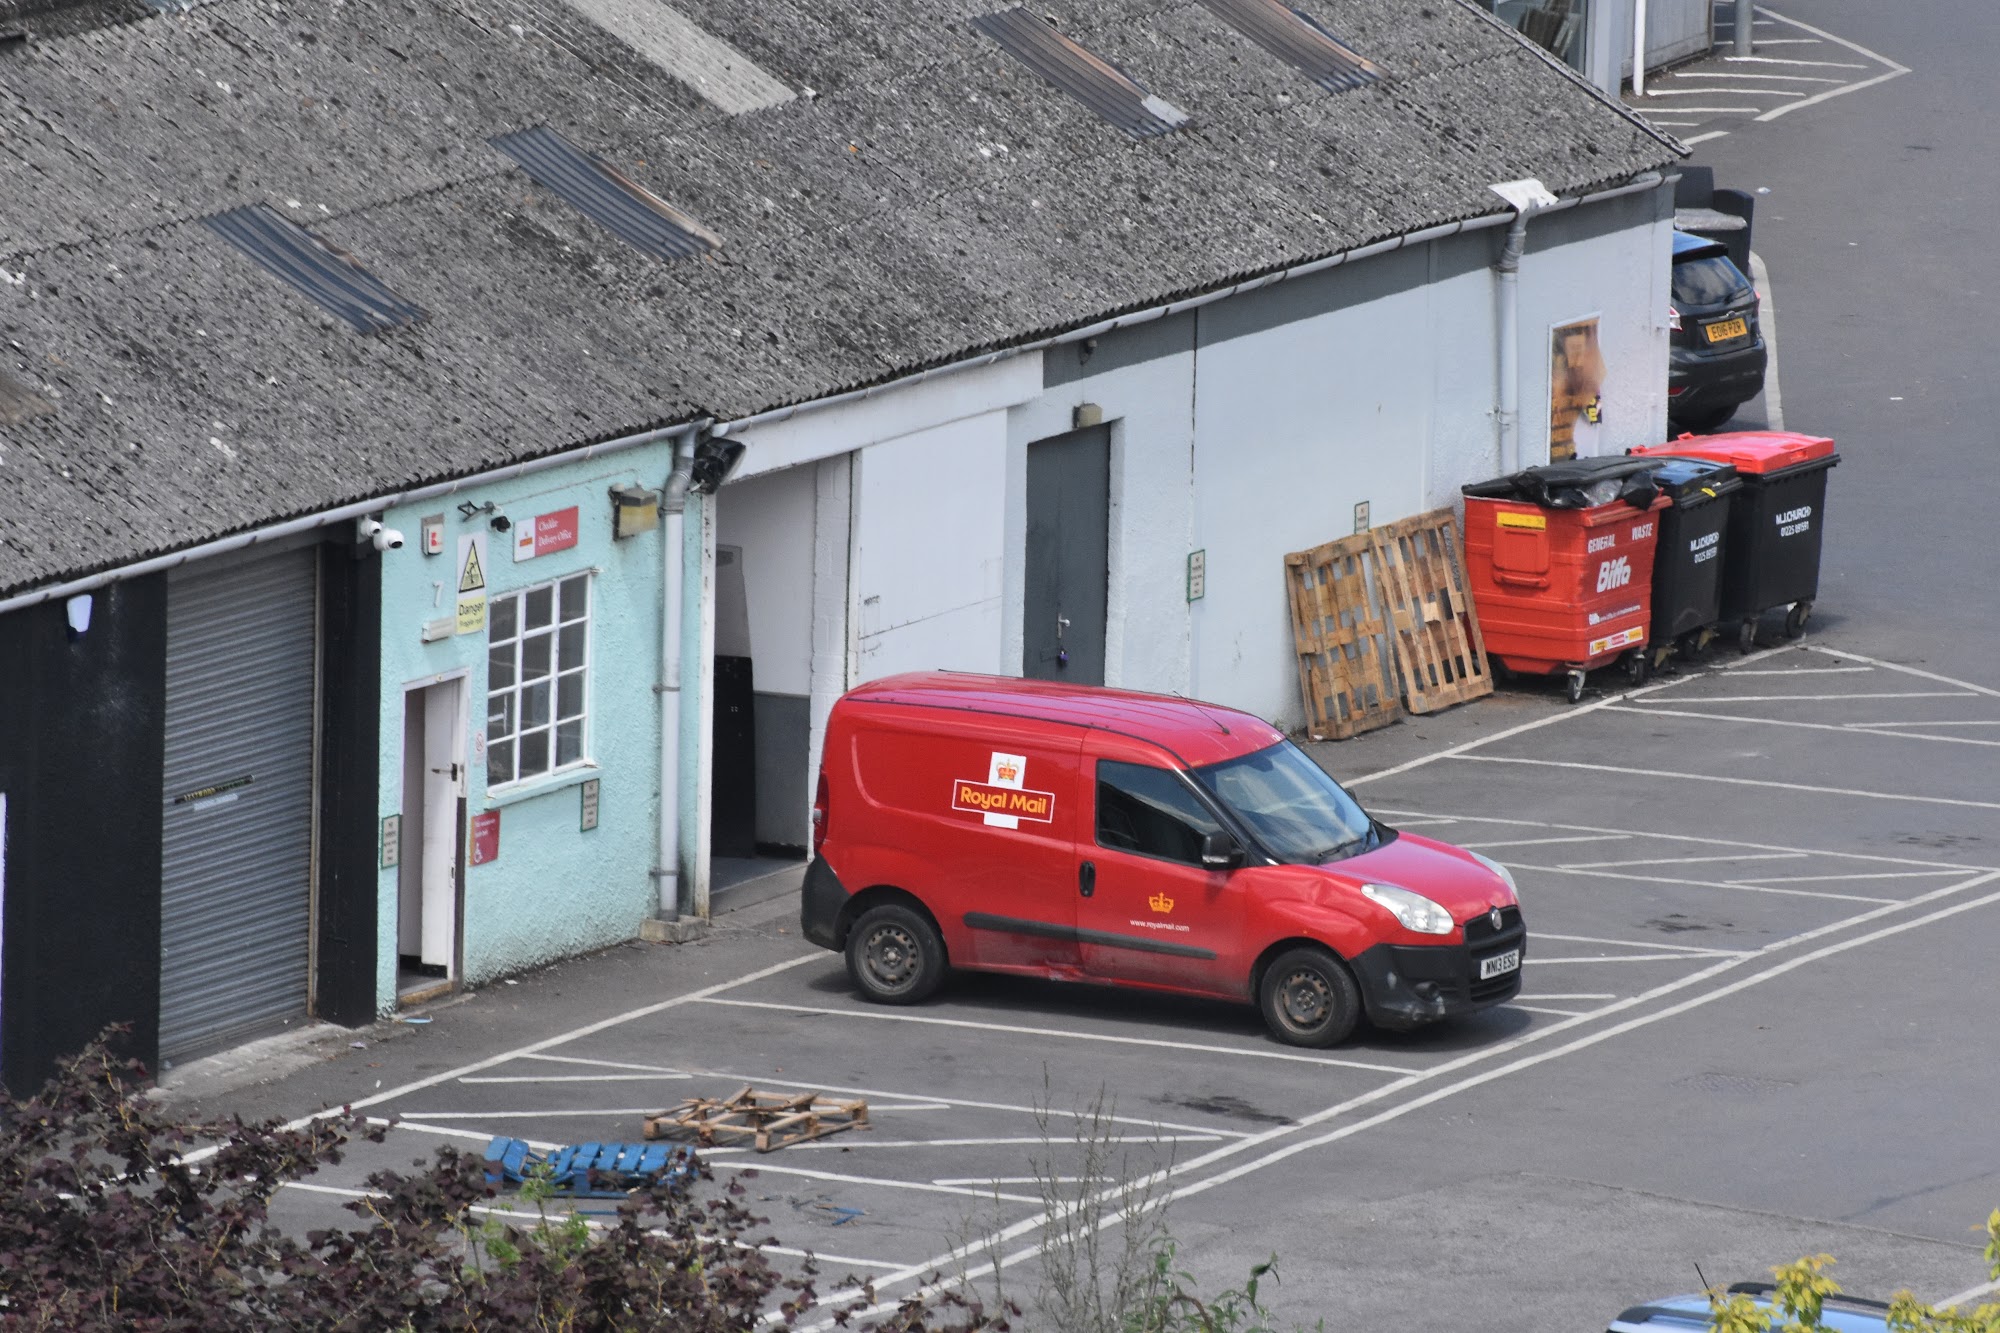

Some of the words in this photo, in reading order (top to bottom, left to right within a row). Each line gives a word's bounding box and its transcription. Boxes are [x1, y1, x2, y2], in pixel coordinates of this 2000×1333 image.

[1711, 323, 1727, 339] EO16
[1728, 321, 1742, 335] PZR
[538, 535, 558, 547] Delivery
[558, 529, 572, 541] Office
[1588, 534, 1616, 554] GENERAL
[1632, 523, 1653, 541] WASTE
[1596, 555, 1632, 593] Biffa
[432, 580, 444, 608] 7
[459, 602, 485, 616] Danger
[960, 785, 1007, 810] Royal
[1009, 793, 1048, 815] Mail
[1129, 919, 1190, 932] www.royalmail.com
[1486, 958, 1502, 975] WN13
[1503, 952, 1515, 970] ESG
